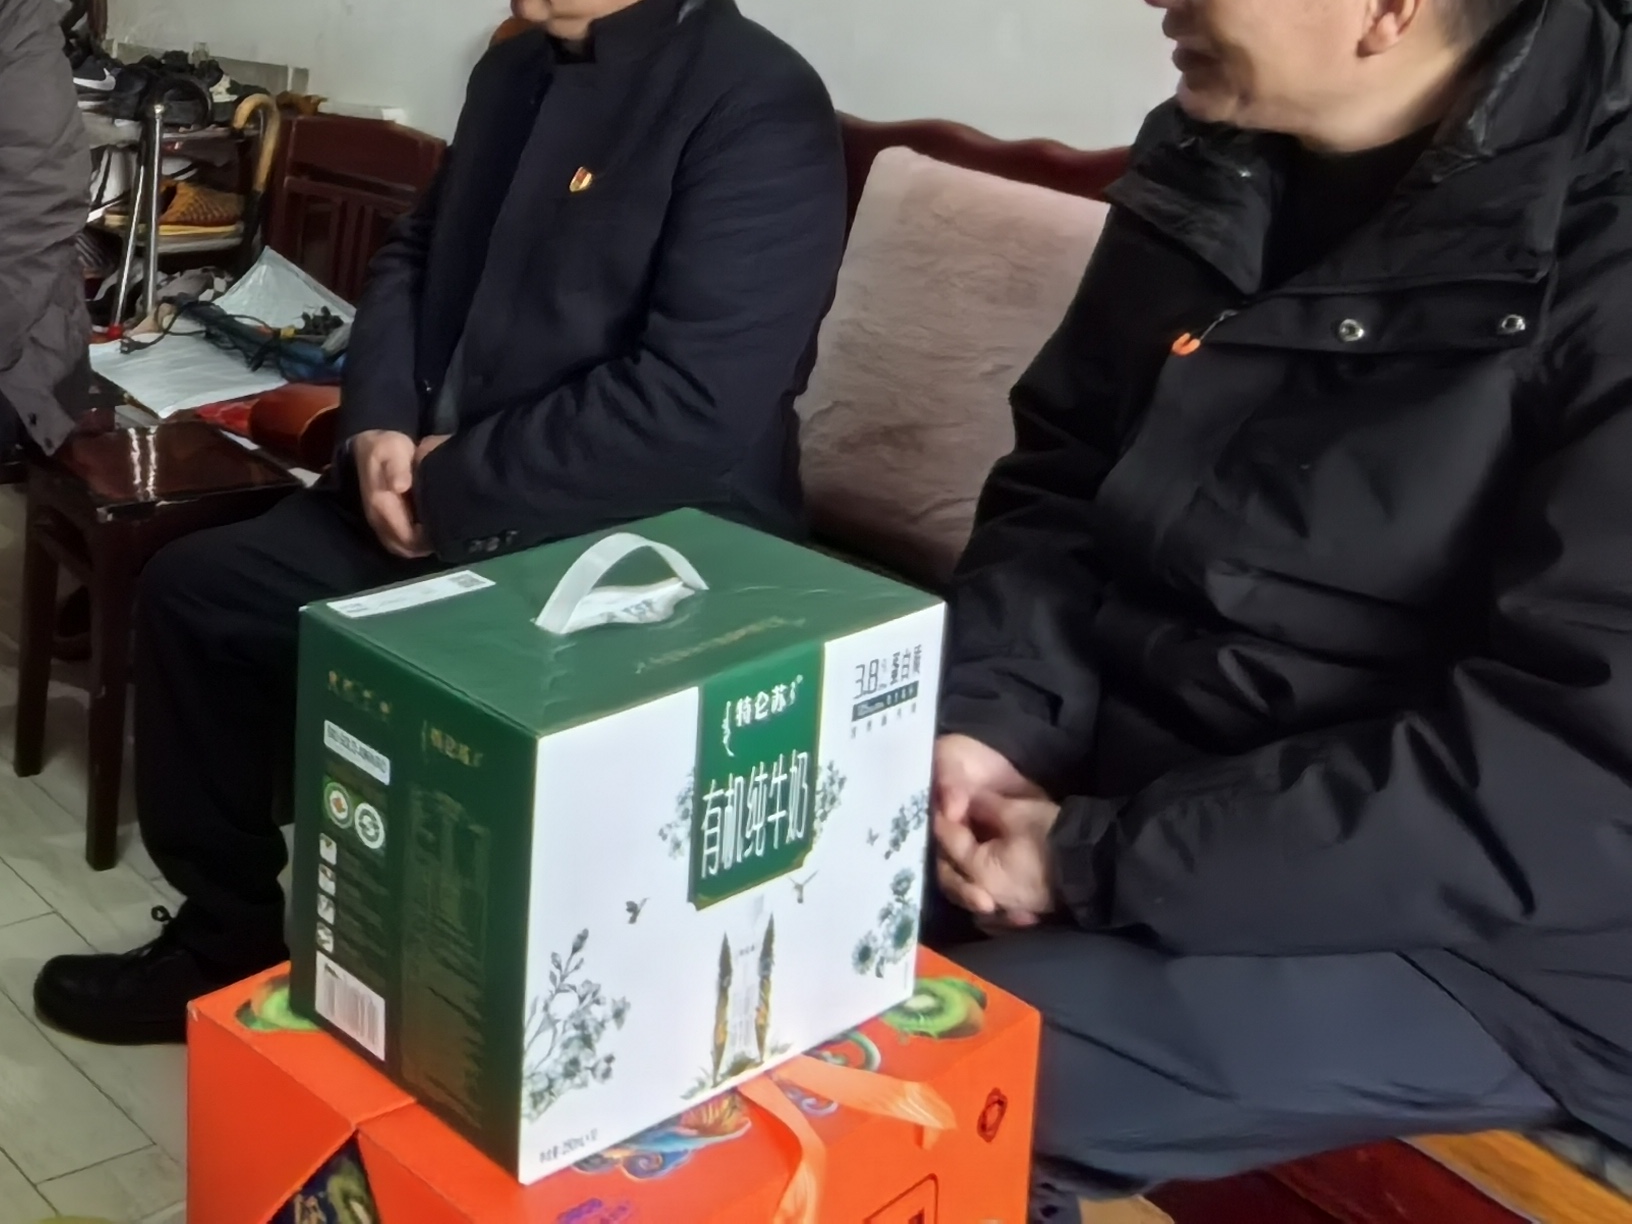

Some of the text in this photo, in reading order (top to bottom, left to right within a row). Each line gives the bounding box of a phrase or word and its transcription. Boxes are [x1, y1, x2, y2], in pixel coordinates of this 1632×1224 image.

[735, 683, 789, 727] 特仑苏
[701, 748, 809, 879] 有机纯牛奶
